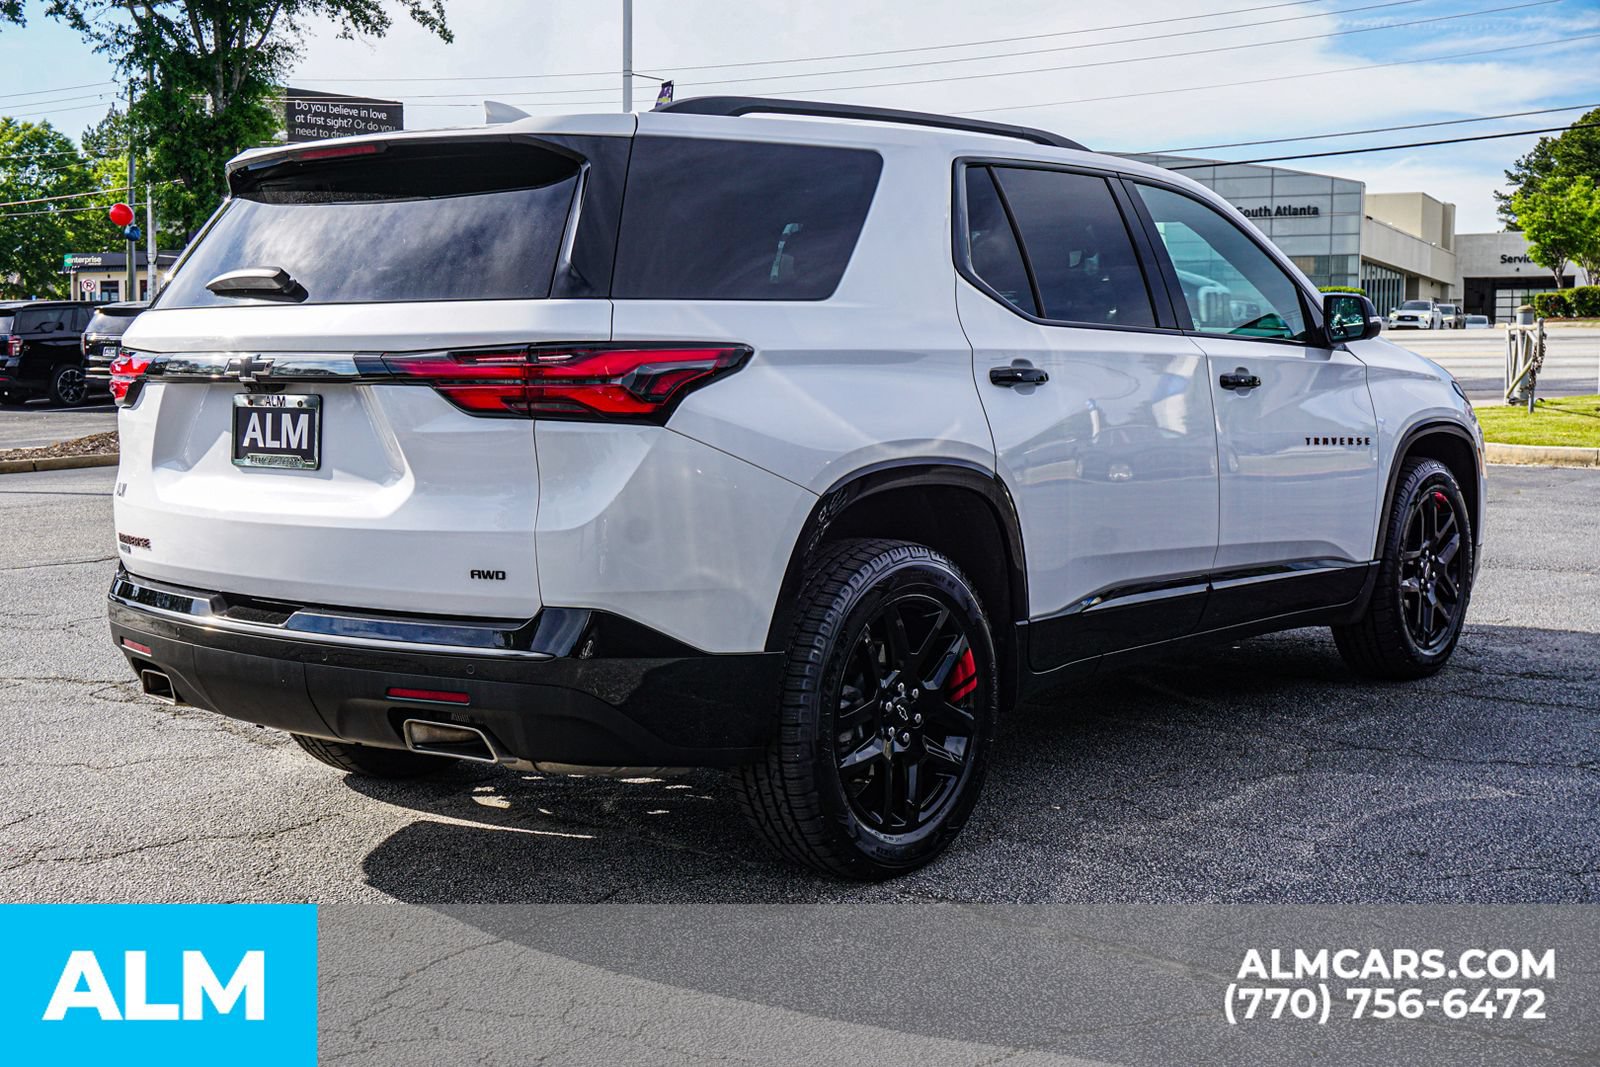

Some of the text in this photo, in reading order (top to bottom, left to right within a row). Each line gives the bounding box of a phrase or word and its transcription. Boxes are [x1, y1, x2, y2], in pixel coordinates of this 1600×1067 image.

[295, 100, 387, 120] Do you believe in love
[295, 115, 305, 123] at
[307, 114, 325, 126] first
[326, 118, 352, 129] sight?
[354, 120, 365, 129] Or
[367, 121, 378, 131] do
[295, 126, 317, 137] need
[319, 129, 329, 138] to
[1236, 204, 1319, 218] South Atlanta
[64, 255, 102, 265] enterprise
[1500, 254, 1535, 264] Servic
[264, 395, 286, 407] ALM
[242, 412, 309, 449] ALM
[1305, 437, 1371, 446] TRAVERSE
[470, 569, 506, 580] AWD
